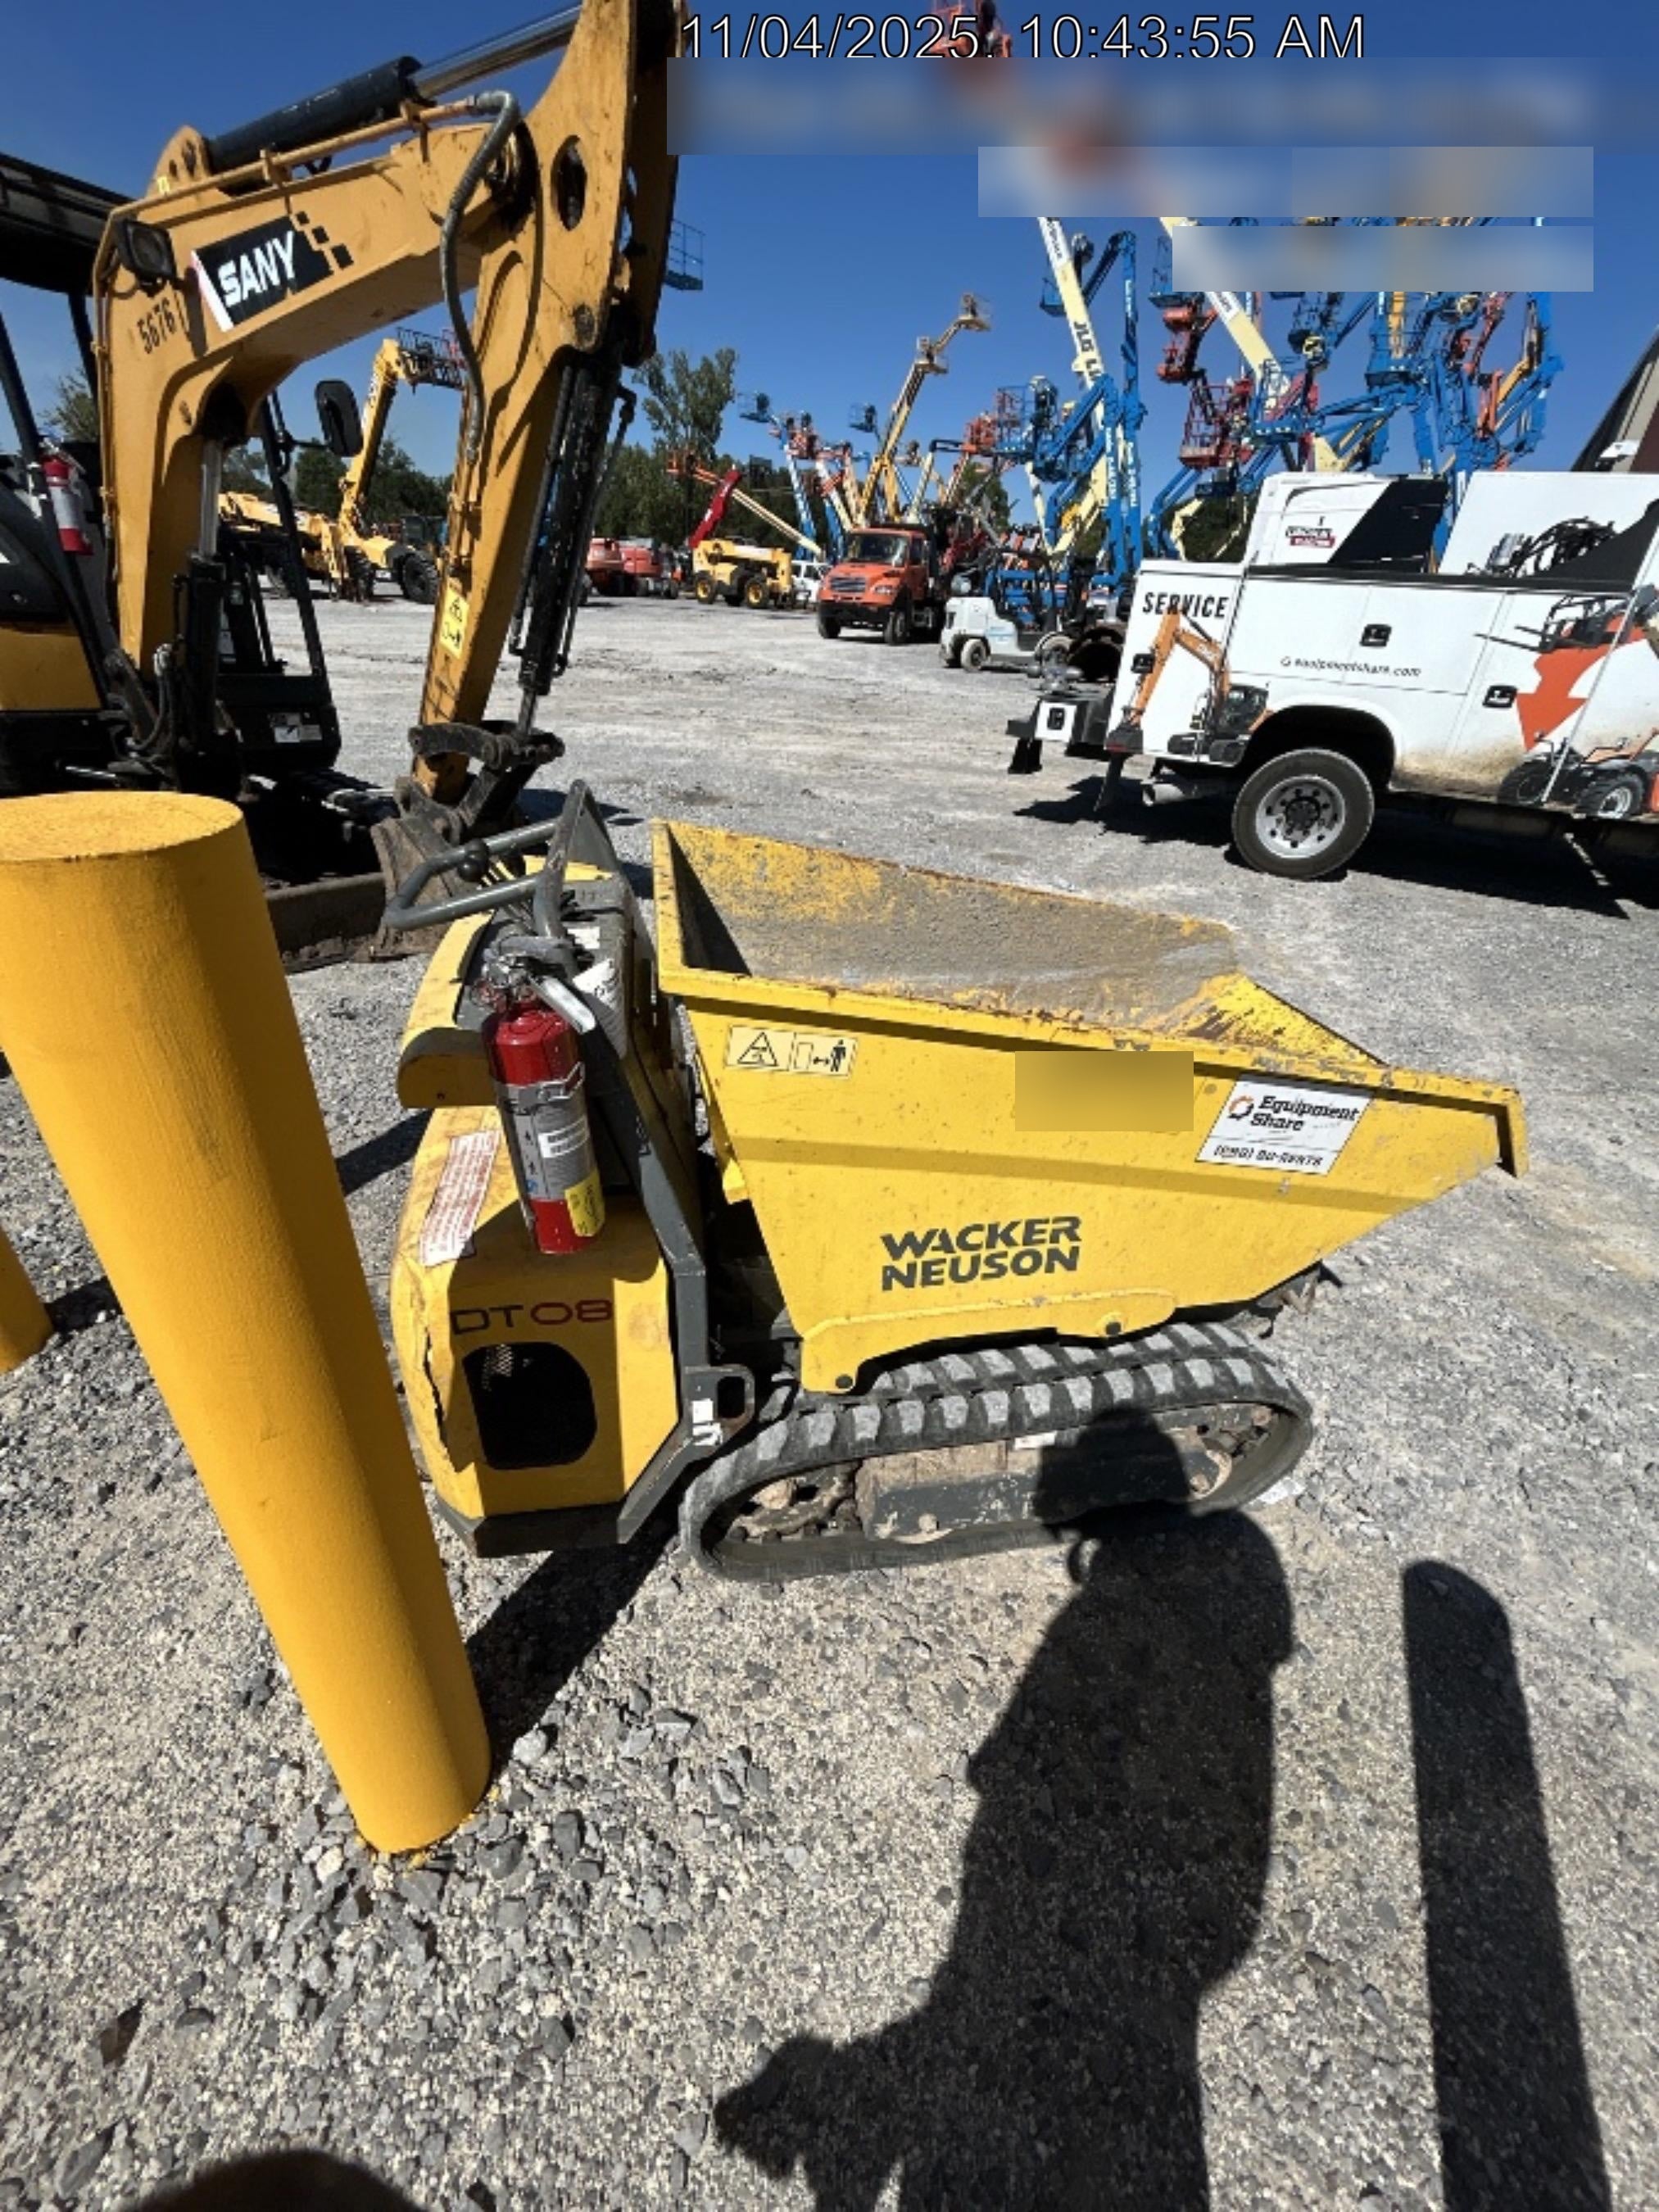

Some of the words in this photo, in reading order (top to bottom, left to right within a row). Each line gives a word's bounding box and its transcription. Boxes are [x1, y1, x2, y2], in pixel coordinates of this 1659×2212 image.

[217, 229, 296, 308] SANY
[1142, 592, 1230, 618] SERVICE
[1250, 1112, 1304, 1131] Share
[1259, 1095, 1360, 1121] Equipment
[880, 1216, 1081, 1261] WACKER
[882, 1245, 1080, 1291] NEUSON
